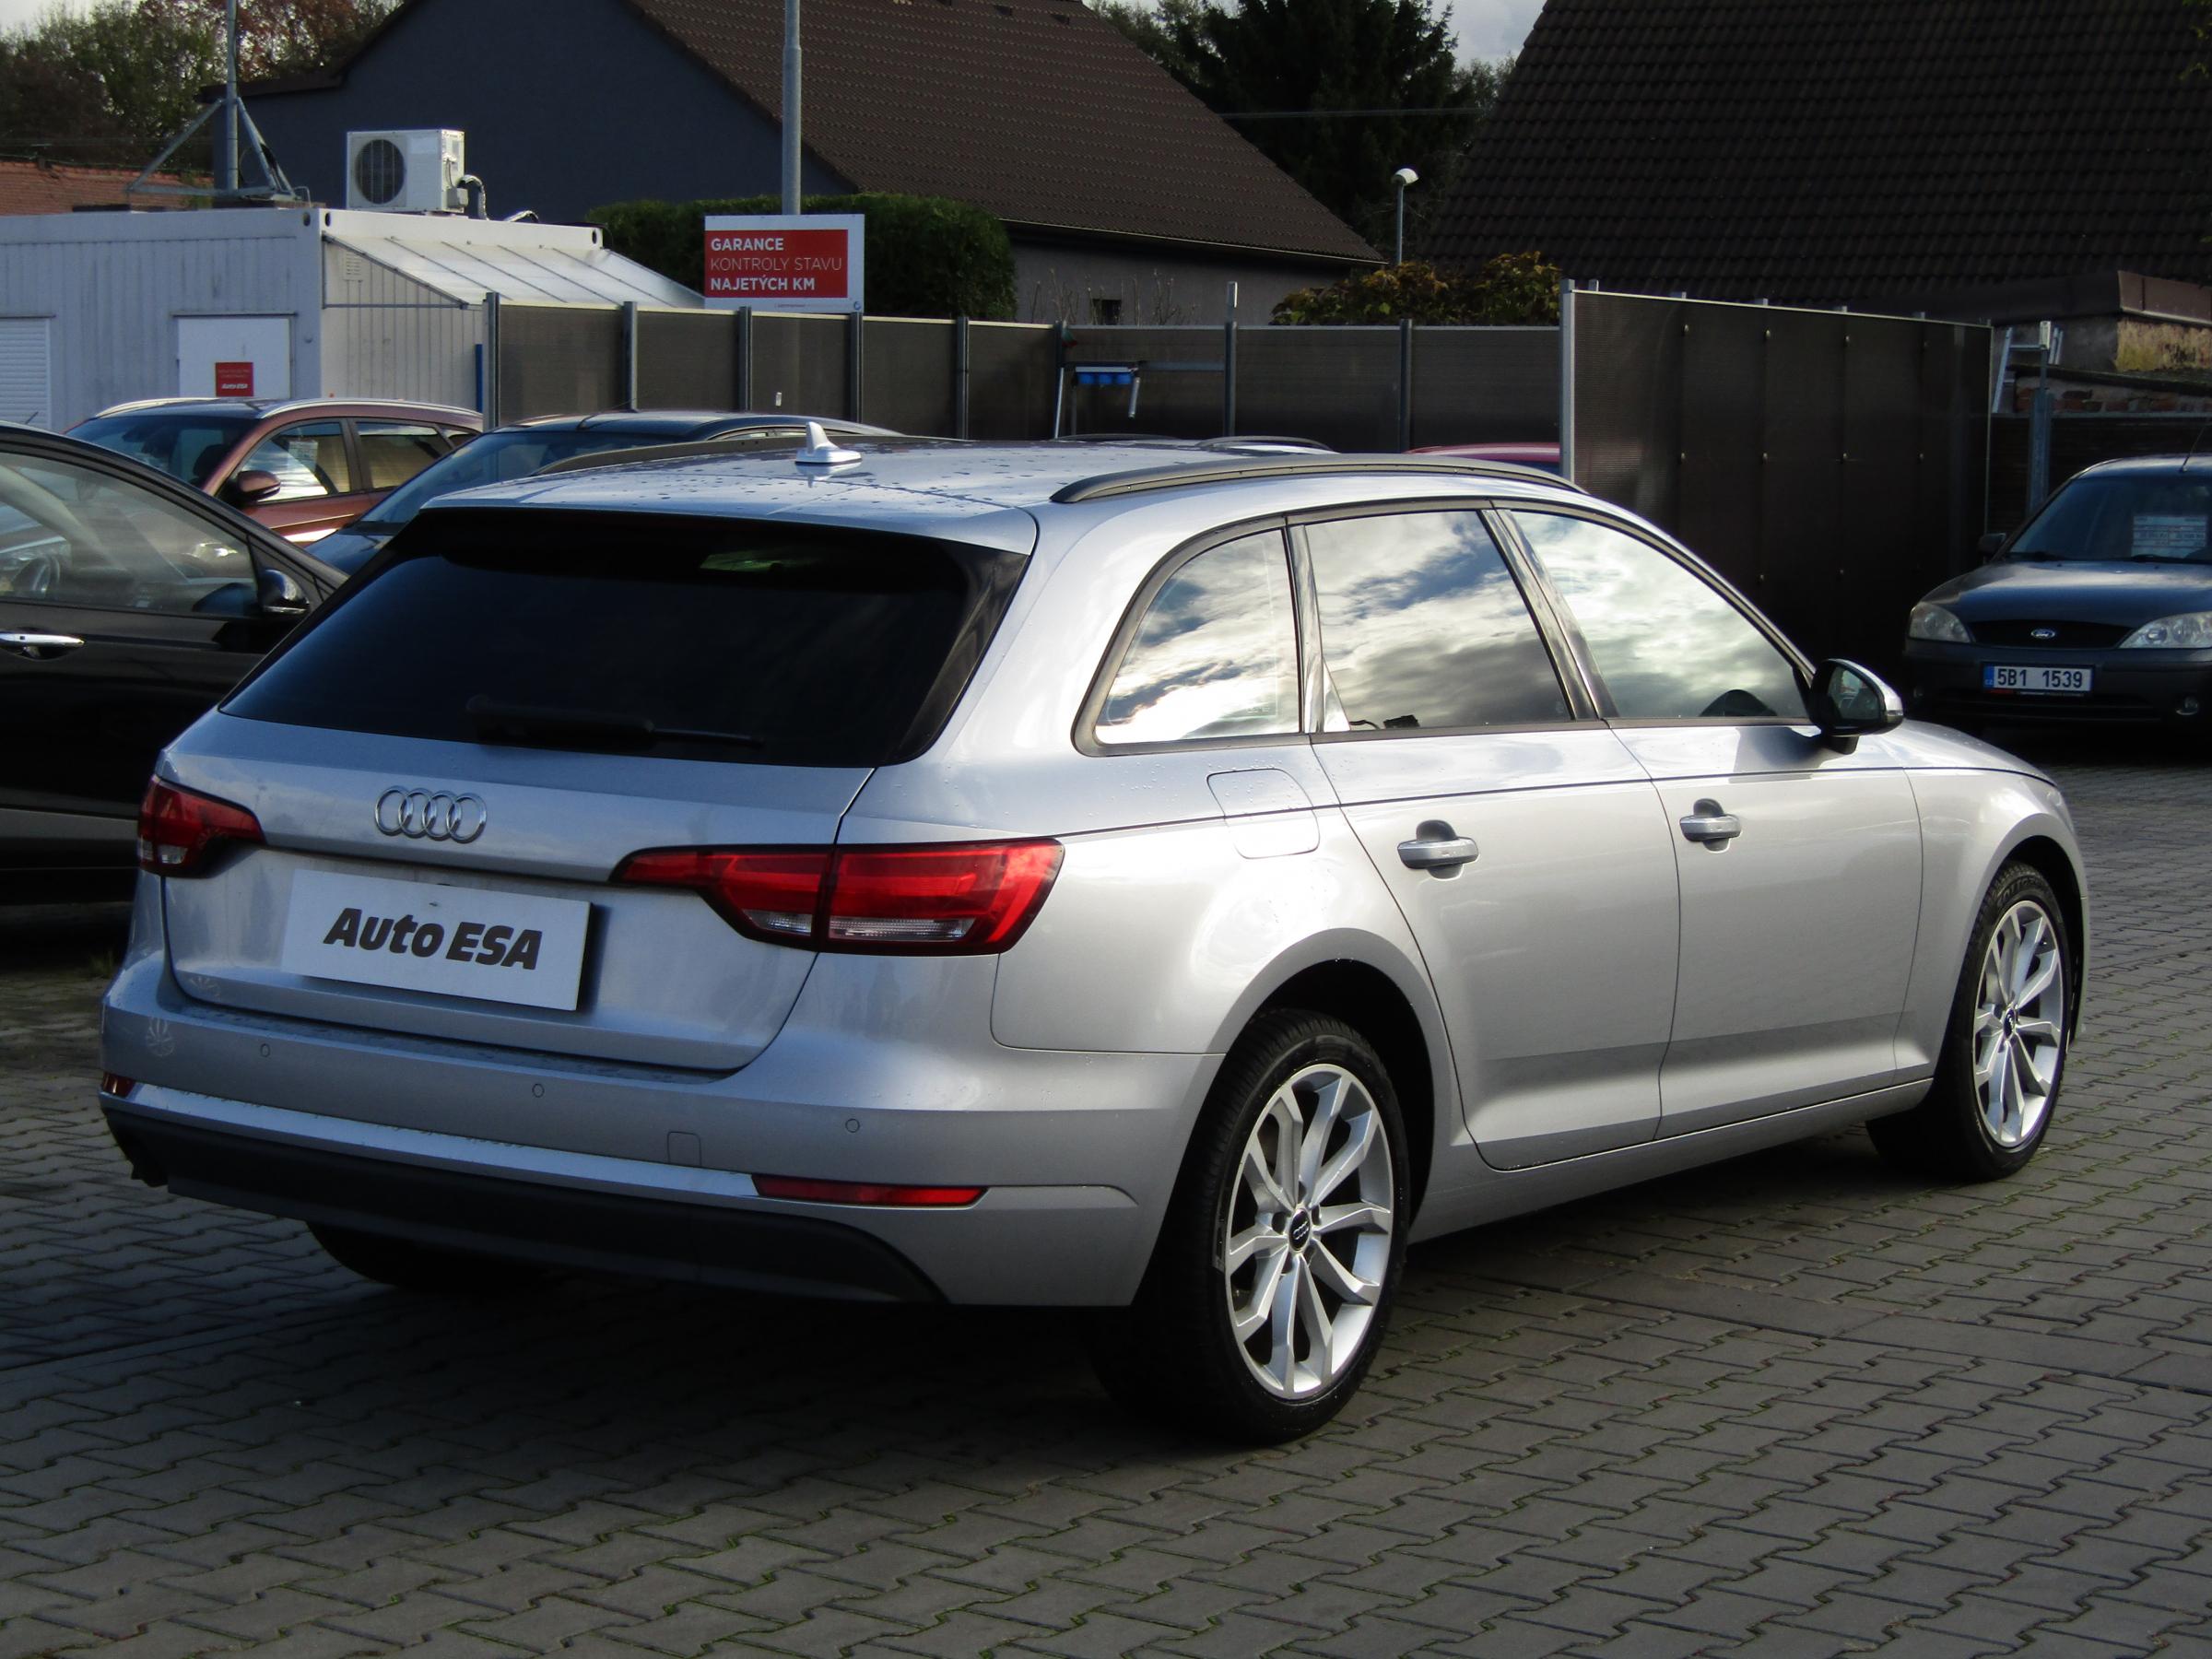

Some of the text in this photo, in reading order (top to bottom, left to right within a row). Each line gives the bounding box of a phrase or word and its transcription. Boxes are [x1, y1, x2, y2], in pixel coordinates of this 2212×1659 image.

[711, 238, 784, 252] GARANCE
[711, 257, 841, 271] KONTROLY STAVU
[711, 275, 815, 290] NAJETÝCH KM
[1997, 668, 2083, 688] 5B1 1539
[324, 907, 543, 971] Auto ESA
